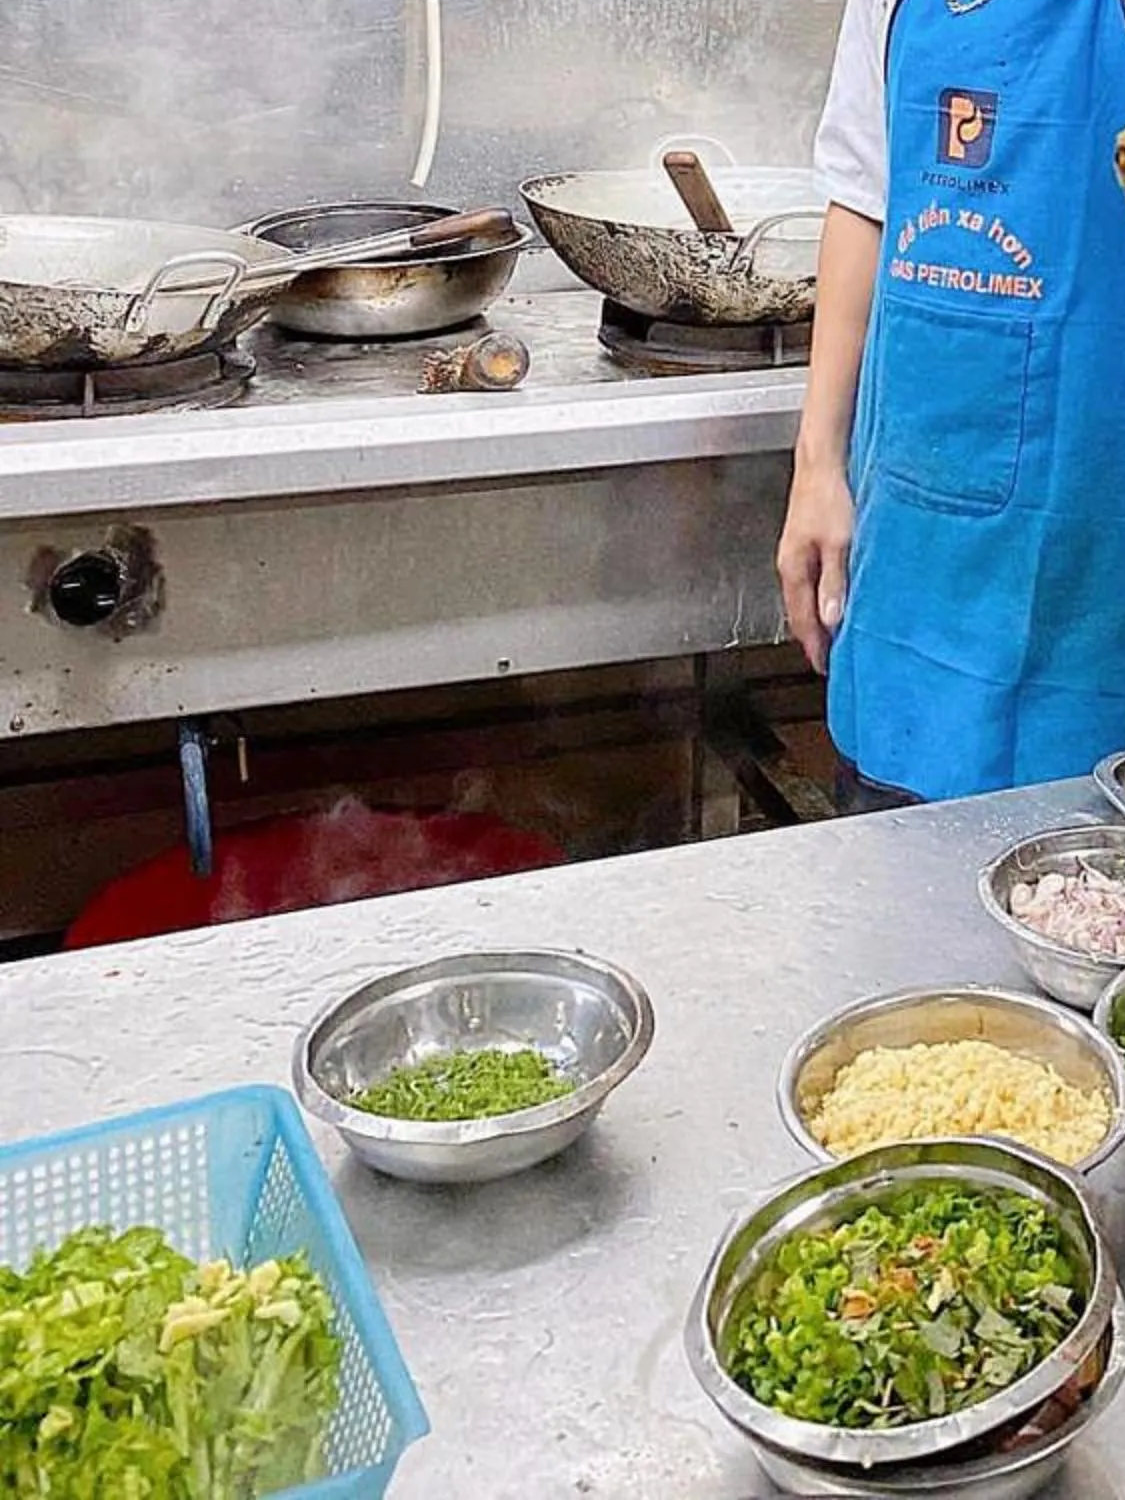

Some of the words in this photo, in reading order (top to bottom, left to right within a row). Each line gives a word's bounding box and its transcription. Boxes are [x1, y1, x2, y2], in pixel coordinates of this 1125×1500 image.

[956, 208, 984, 232] xa
[890, 257, 914, 281] GAS
[917, 263, 1043, 299] PETROLIMEX
